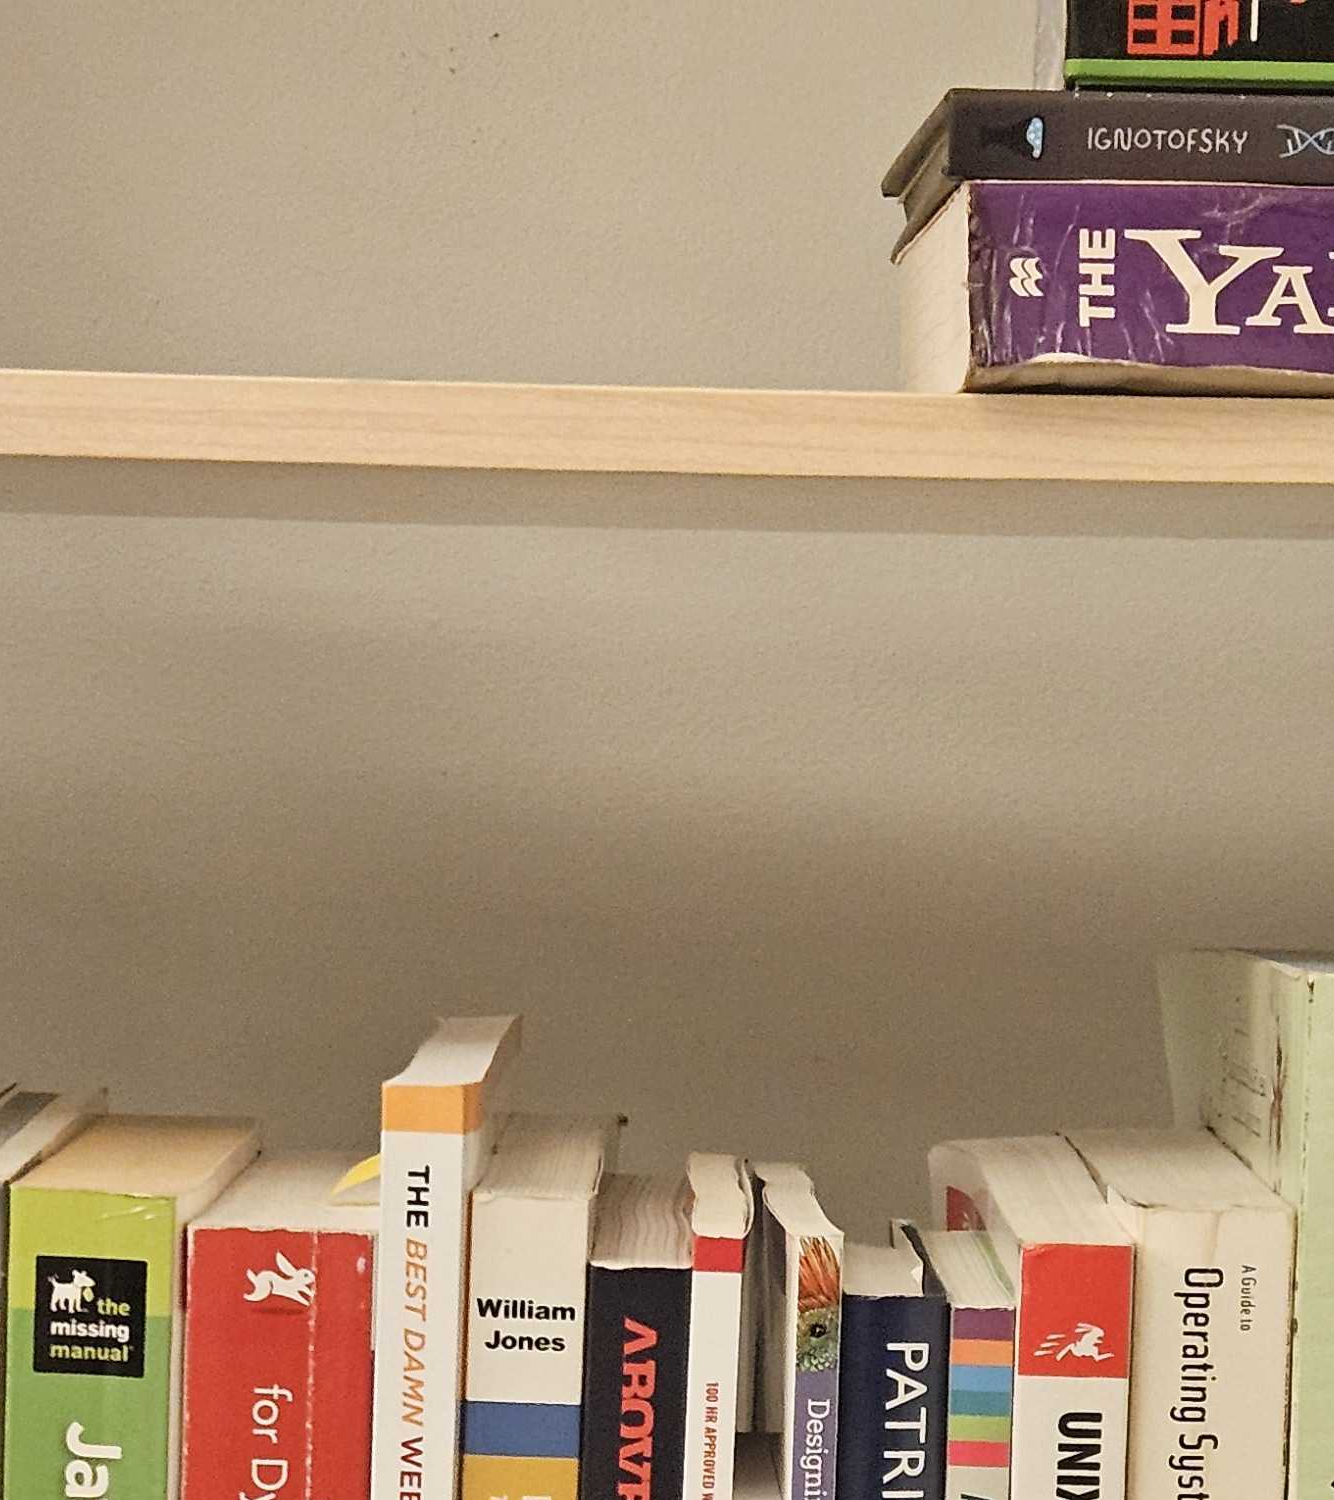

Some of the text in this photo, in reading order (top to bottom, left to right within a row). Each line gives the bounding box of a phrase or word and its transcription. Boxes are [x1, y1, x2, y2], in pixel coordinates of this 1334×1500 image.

[1088, 128, 1247, 153] IGNOTOFSKY
[1079, 229, 1115, 327] THE
[407, 1165, 429, 1227] THE
[405, 1238, 427, 1322] BEST
[97, 1298, 130, 1316] the
[477, 1298, 575, 1320] William
[51, 1319, 129, 1342] missing
[485, 1331, 565, 1351] Jones
[1170, 1269, 1223, 1422] Operating
[50, 1344, 128, 1361] manual
[402, 1328, 425, 1426] DAMN
[250, 1383, 293, 1442] for
